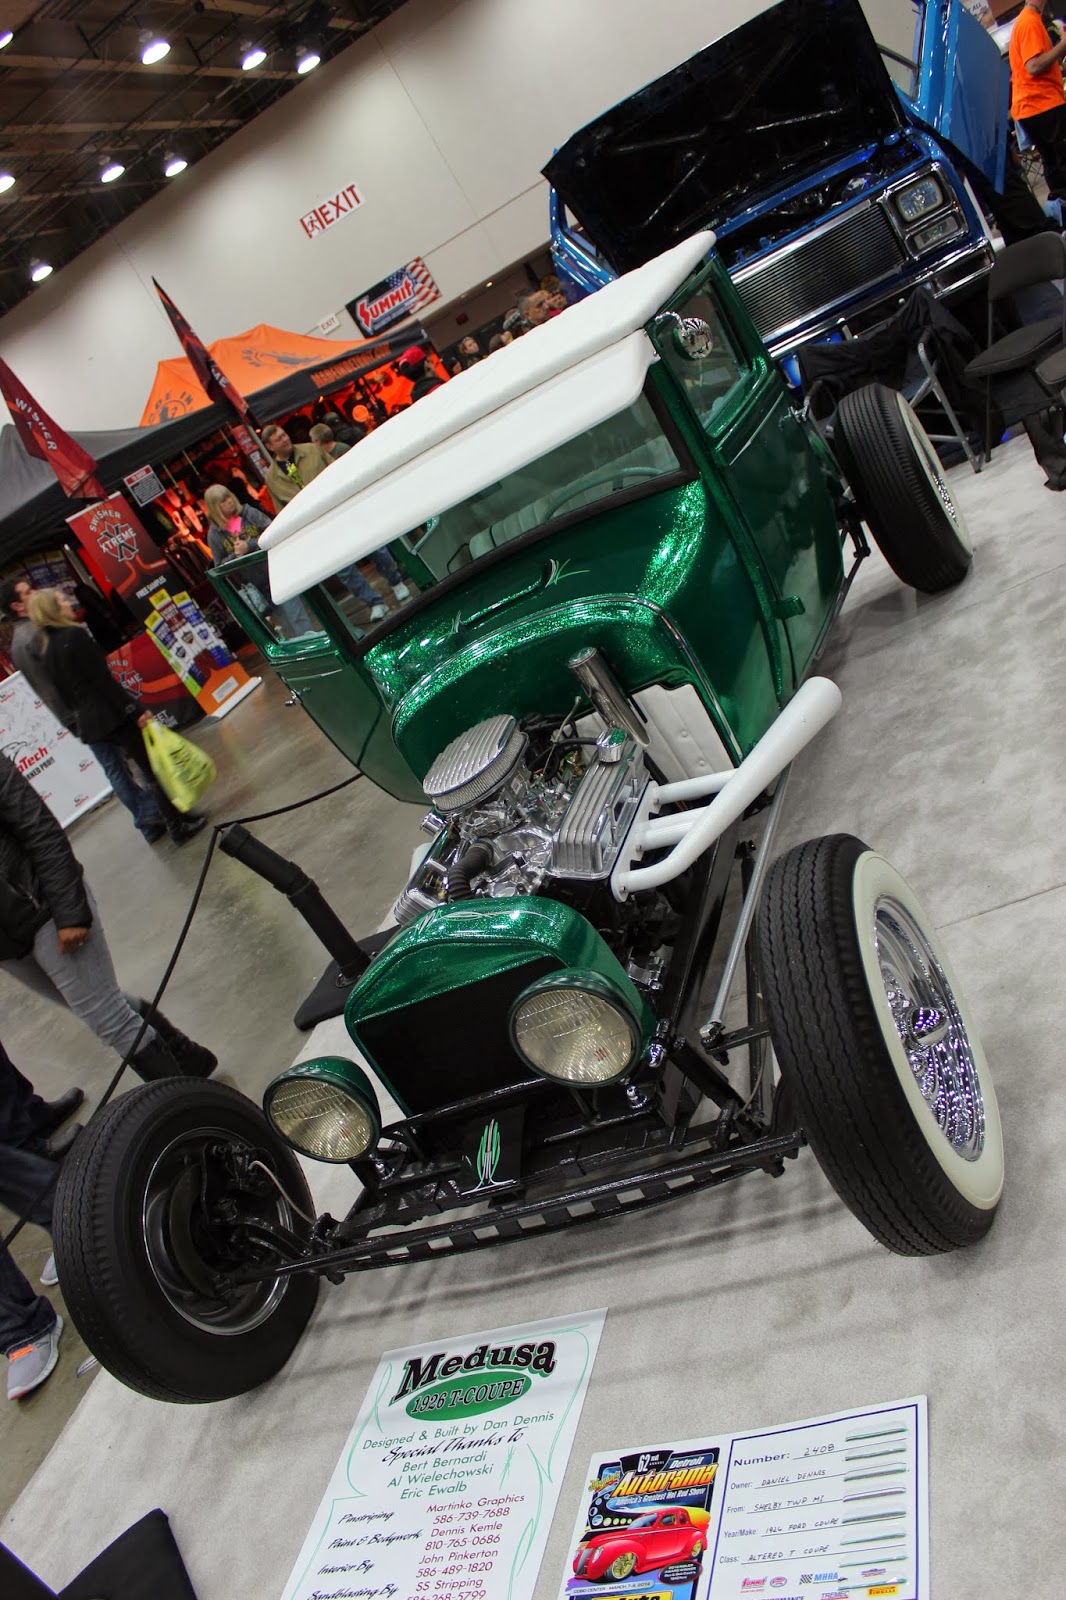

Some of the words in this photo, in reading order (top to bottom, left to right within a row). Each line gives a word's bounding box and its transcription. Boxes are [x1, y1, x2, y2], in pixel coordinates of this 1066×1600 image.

[318, 184, 361, 225] EXIT
[320, 317, 337, 331] EXIT
[89, 510, 121, 532] SWISHER
[102, 528, 136, 553] XTREME
[388, 1341, 557, 1407] Medusa
[411, 1392, 446, 1413] 1926
[448, 1378, 526, 1408] T-COUPE
[363, 1431, 415, 1450] Designed
[419, 1430, 428, 1441] &
[434, 1424, 459, 1438] Built
[464, 1422, 479, 1435] by
[483, 1420, 507, 1431] Dan
[513, 1411, 554, 1426] Dennis
[382, 1440, 446, 1466] Special
[443, 1432, 505, 1453] Thanks
[507, 1426, 529, 1443] To
[402, 1460, 428, 1473] Bert
[432, 1451, 488, 1468] Bernardi
[637, 1453, 651, 1473] 62
[669, 1456, 705, 1469] Detroit
[733, 1453, 790, 1467] Number:
[387, 1475, 402, 1488] Al
[408, 1463, 494, 1485] Wielechowski
[610, 1462, 718, 1498] Autorama
[761, 1477, 790, 1486] DANIEL
[797, 1469, 826, 1480] DENNIS
[400, 1487, 423, 1500] Eric
[428, 1481, 467, 1496] Ewalb
[730, 1482, 753, 1490] Owner:
[426, 1500, 472, 1513] Martinko
[477, 1493, 525, 1508] Graphics
[615, 1496, 642, 1506] America's
[643, 1492, 667, 1503] Greatest
[688, 1487, 706, 1496] Show
[754, 1501, 782, 1511] SHELBY
[787, 1496, 808, 1507] TWP
[433, 1506, 510, 1525] 586-739-7688
[727, 1505, 746, 1513] From:
[337, 1511, 395, 1525] Pinstriping
[765, 1526, 782, 1534] 1926
[788, 1522, 807, 1530] FORD
[814, 1518, 839, 1527] COUPE
[430, 1525, 465, 1537] Dennis
[469, 1521, 503, 1533] Kemle
[724, 1528, 758, 1538] Year/Make:
[328, 1537, 356, 1550] Paint
[366, 1529, 424, 1546] Bodywork
[425, 1533, 501, 1551] 810-765-0686
[419, 1553, 443, 1565] John
[448, 1549, 498, 1561] Pinkerton
[719, 1555, 740, 1564] Class:
[748, 1551, 783, 1561] ALTERED
[803, 1545, 830, 1554] COUPE
[317, 1564, 357, 1575] Interior
[355, 1559, 375, 1574] By
[416, 1561, 493, 1578] 586-489-1820
[307, 1587, 380, 1600] Sandblasting
[379, 1583, 399, 1599] By
[416, 1581, 430, 1592] SS
[434, 1577, 483, 1591] Stripping
[821, 1590, 850, 1598] TREMEC
